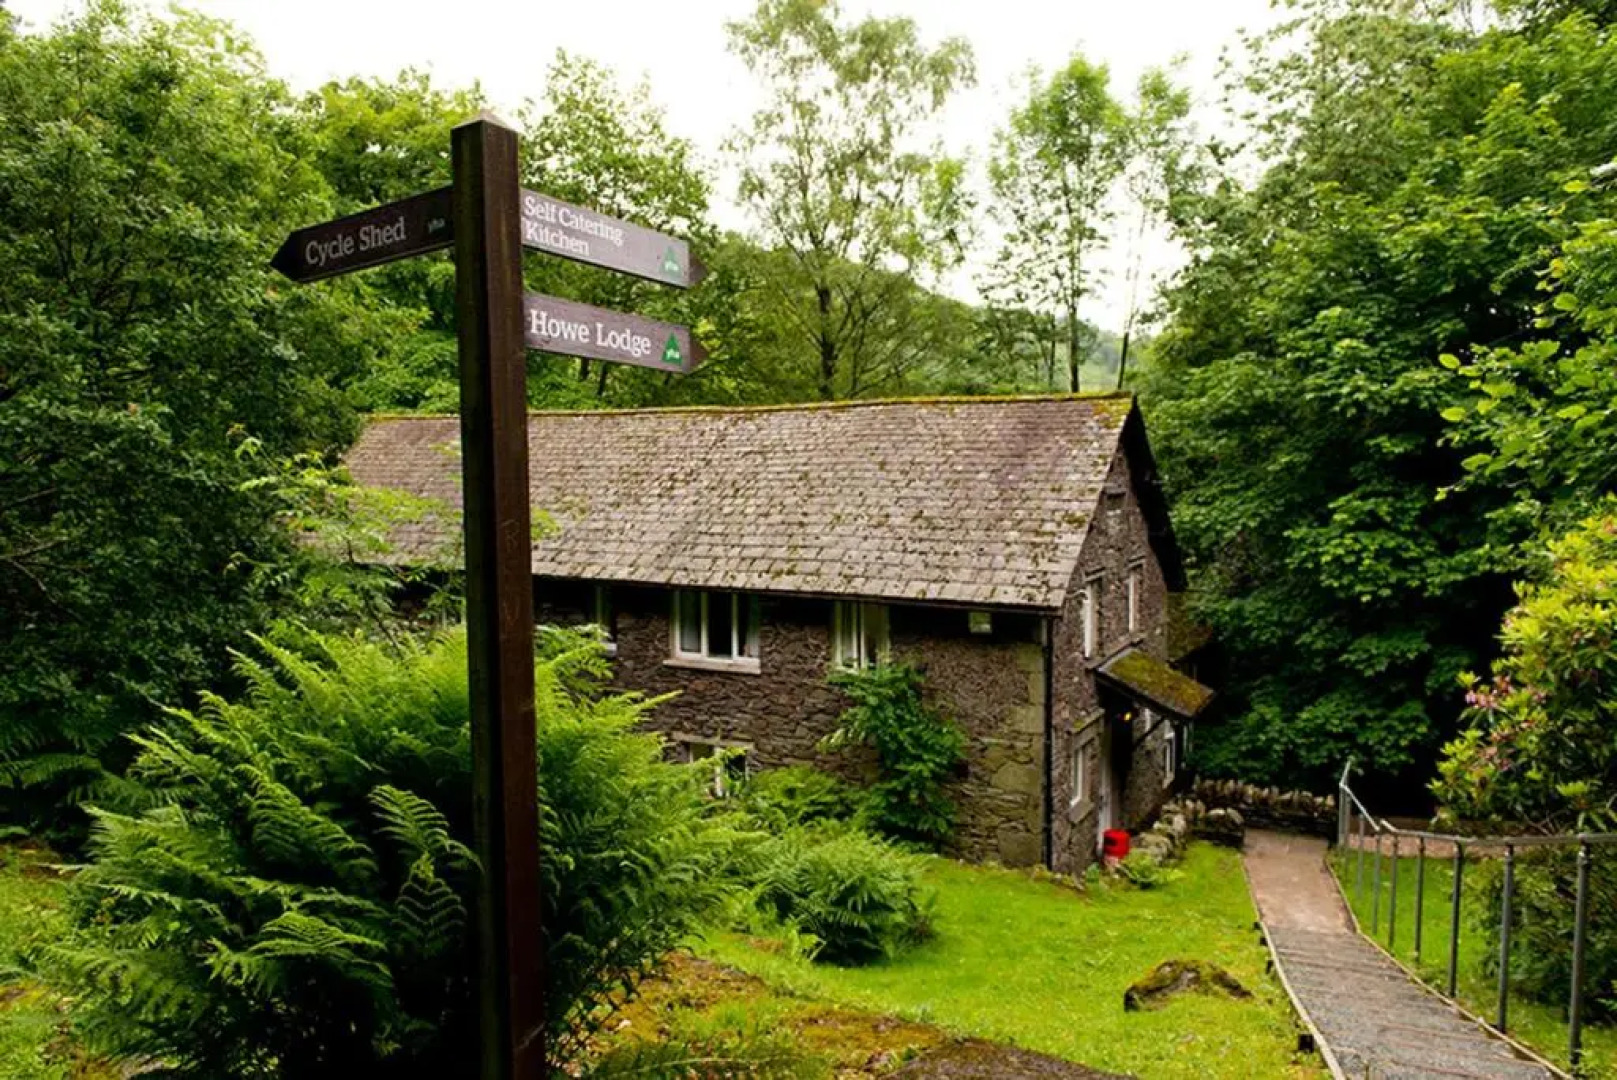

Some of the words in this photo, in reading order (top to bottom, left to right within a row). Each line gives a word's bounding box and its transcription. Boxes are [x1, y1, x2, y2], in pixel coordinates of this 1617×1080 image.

[305, 233, 355, 266] Cycle
[359, 216, 407, 250] Shed
[523, 195, 556, 222] Self
[558, 207, 624, 247] Catering
[525, 220, 590, 256] Kitchen
[529, 308, 590, 343] Howe
[595, 322, 652, 357] Lodge
